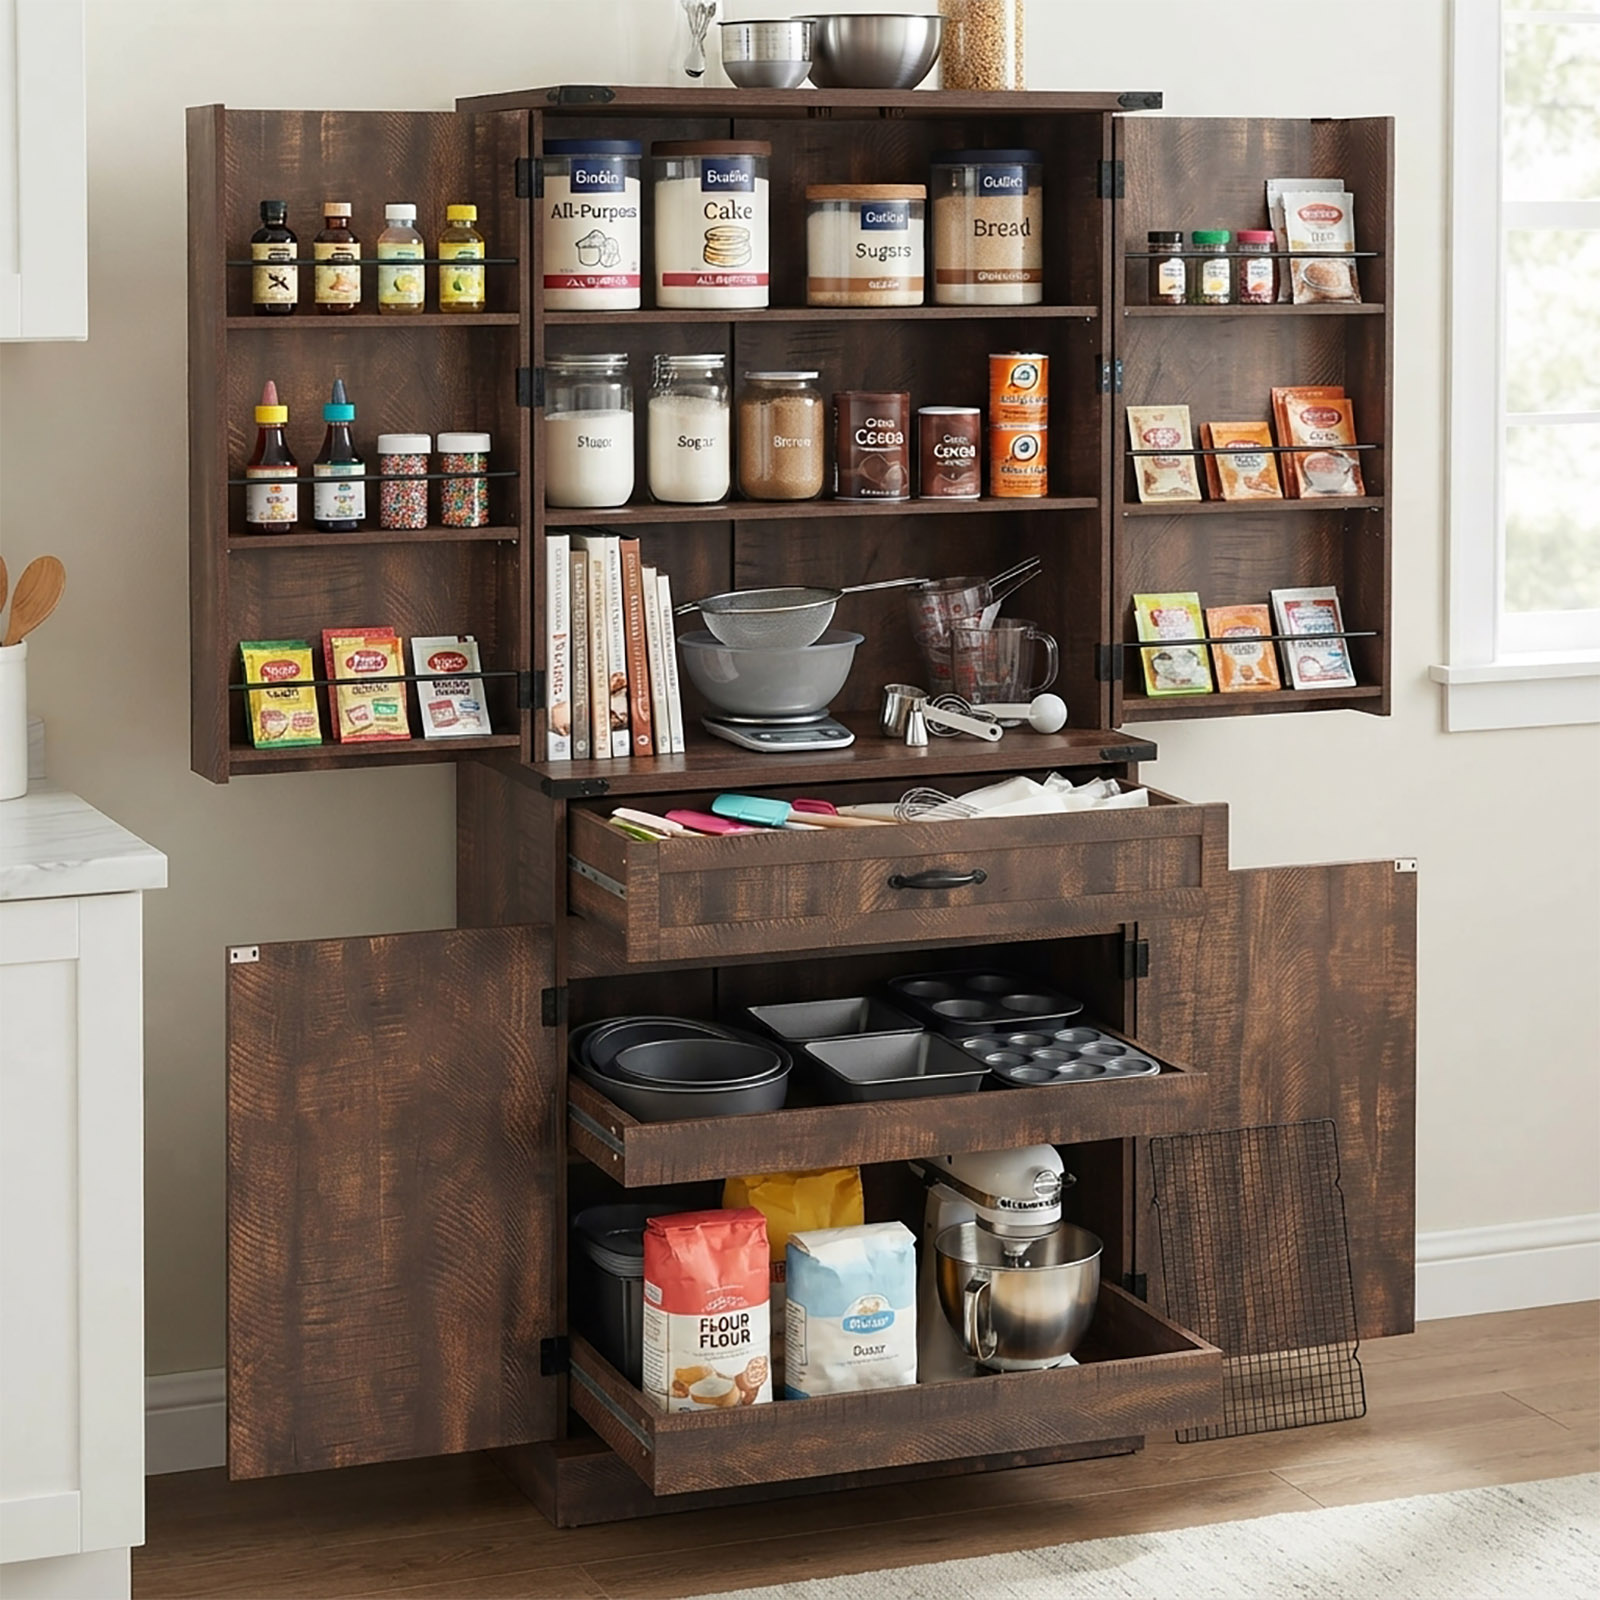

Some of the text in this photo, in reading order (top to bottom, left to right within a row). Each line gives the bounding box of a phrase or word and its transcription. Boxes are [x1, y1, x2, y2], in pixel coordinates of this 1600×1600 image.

[704, 199, 753, 220] Cake
[973, 217, 1031, 237] Bread
[699, 1329, 751, 1348] FLOUR
